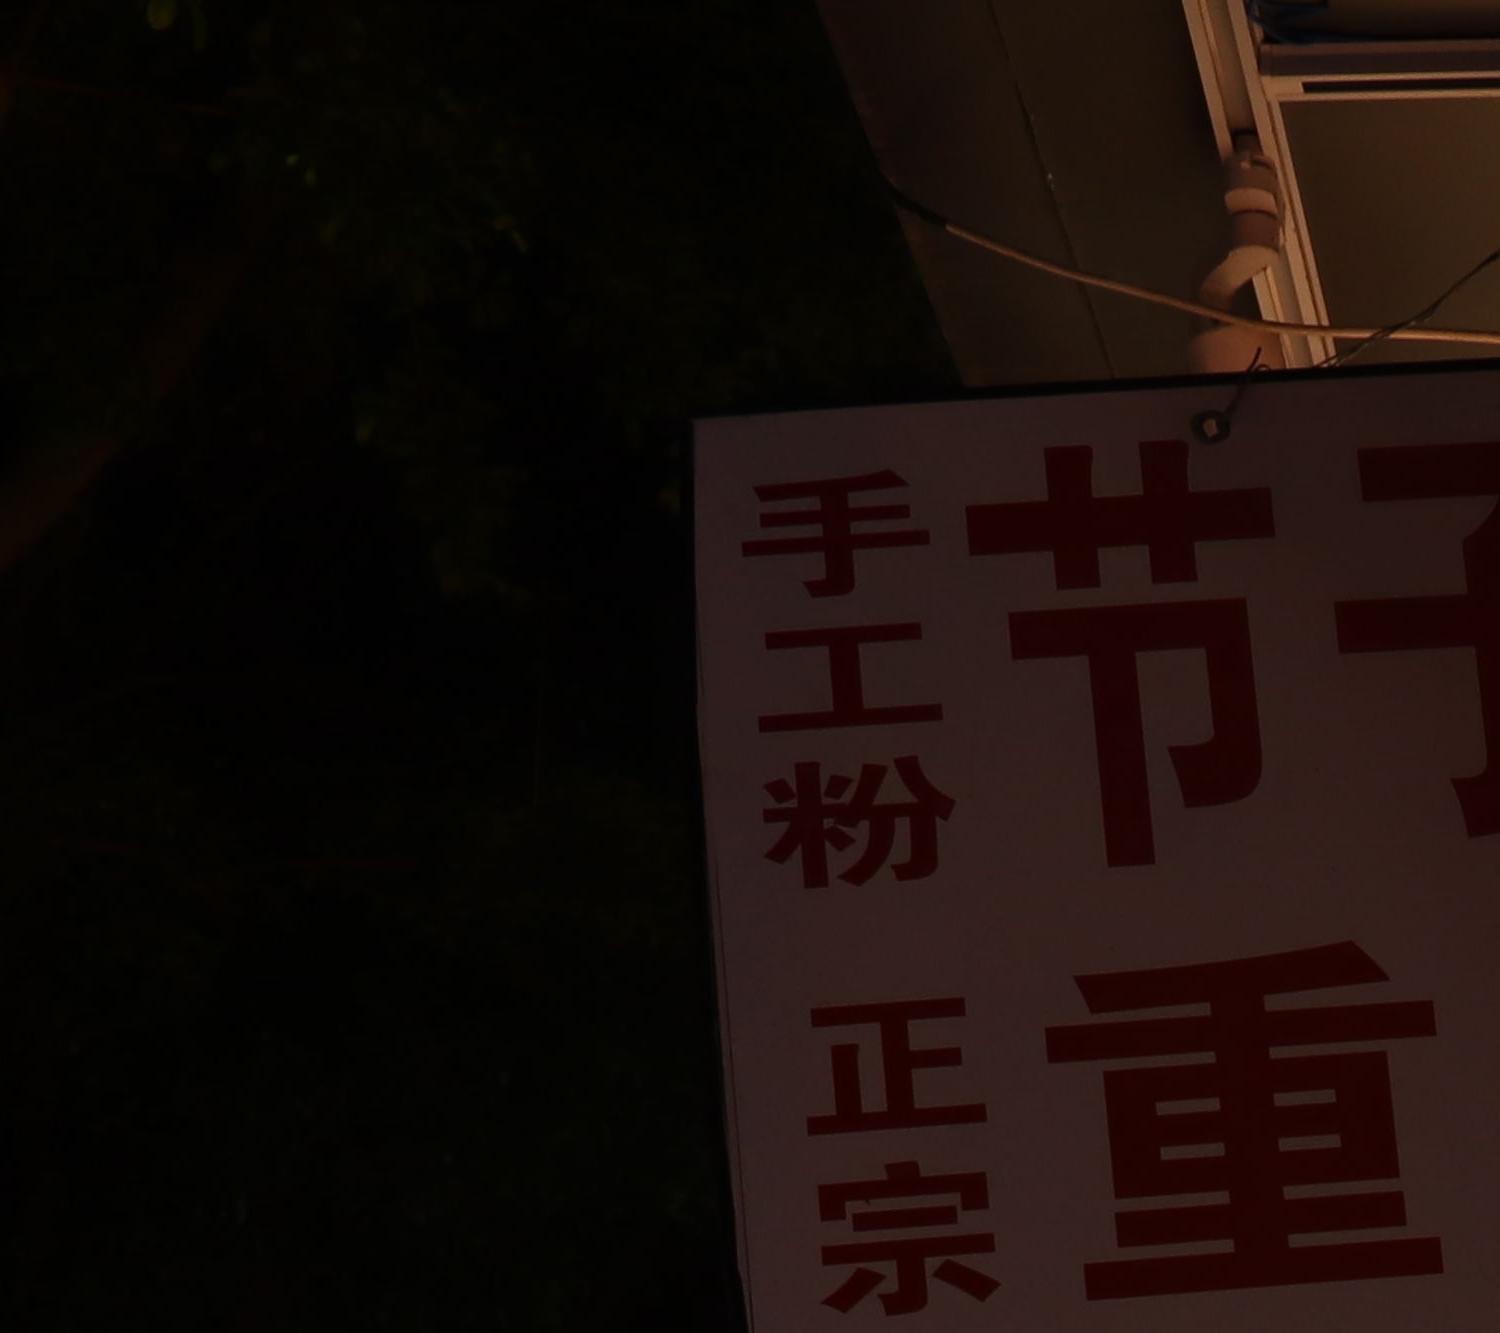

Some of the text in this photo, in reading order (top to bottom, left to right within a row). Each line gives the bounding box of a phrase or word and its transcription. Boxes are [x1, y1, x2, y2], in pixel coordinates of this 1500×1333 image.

[743, 471, 953, 887] 手工粉
[808, 999, 997, 1315] 正宗
